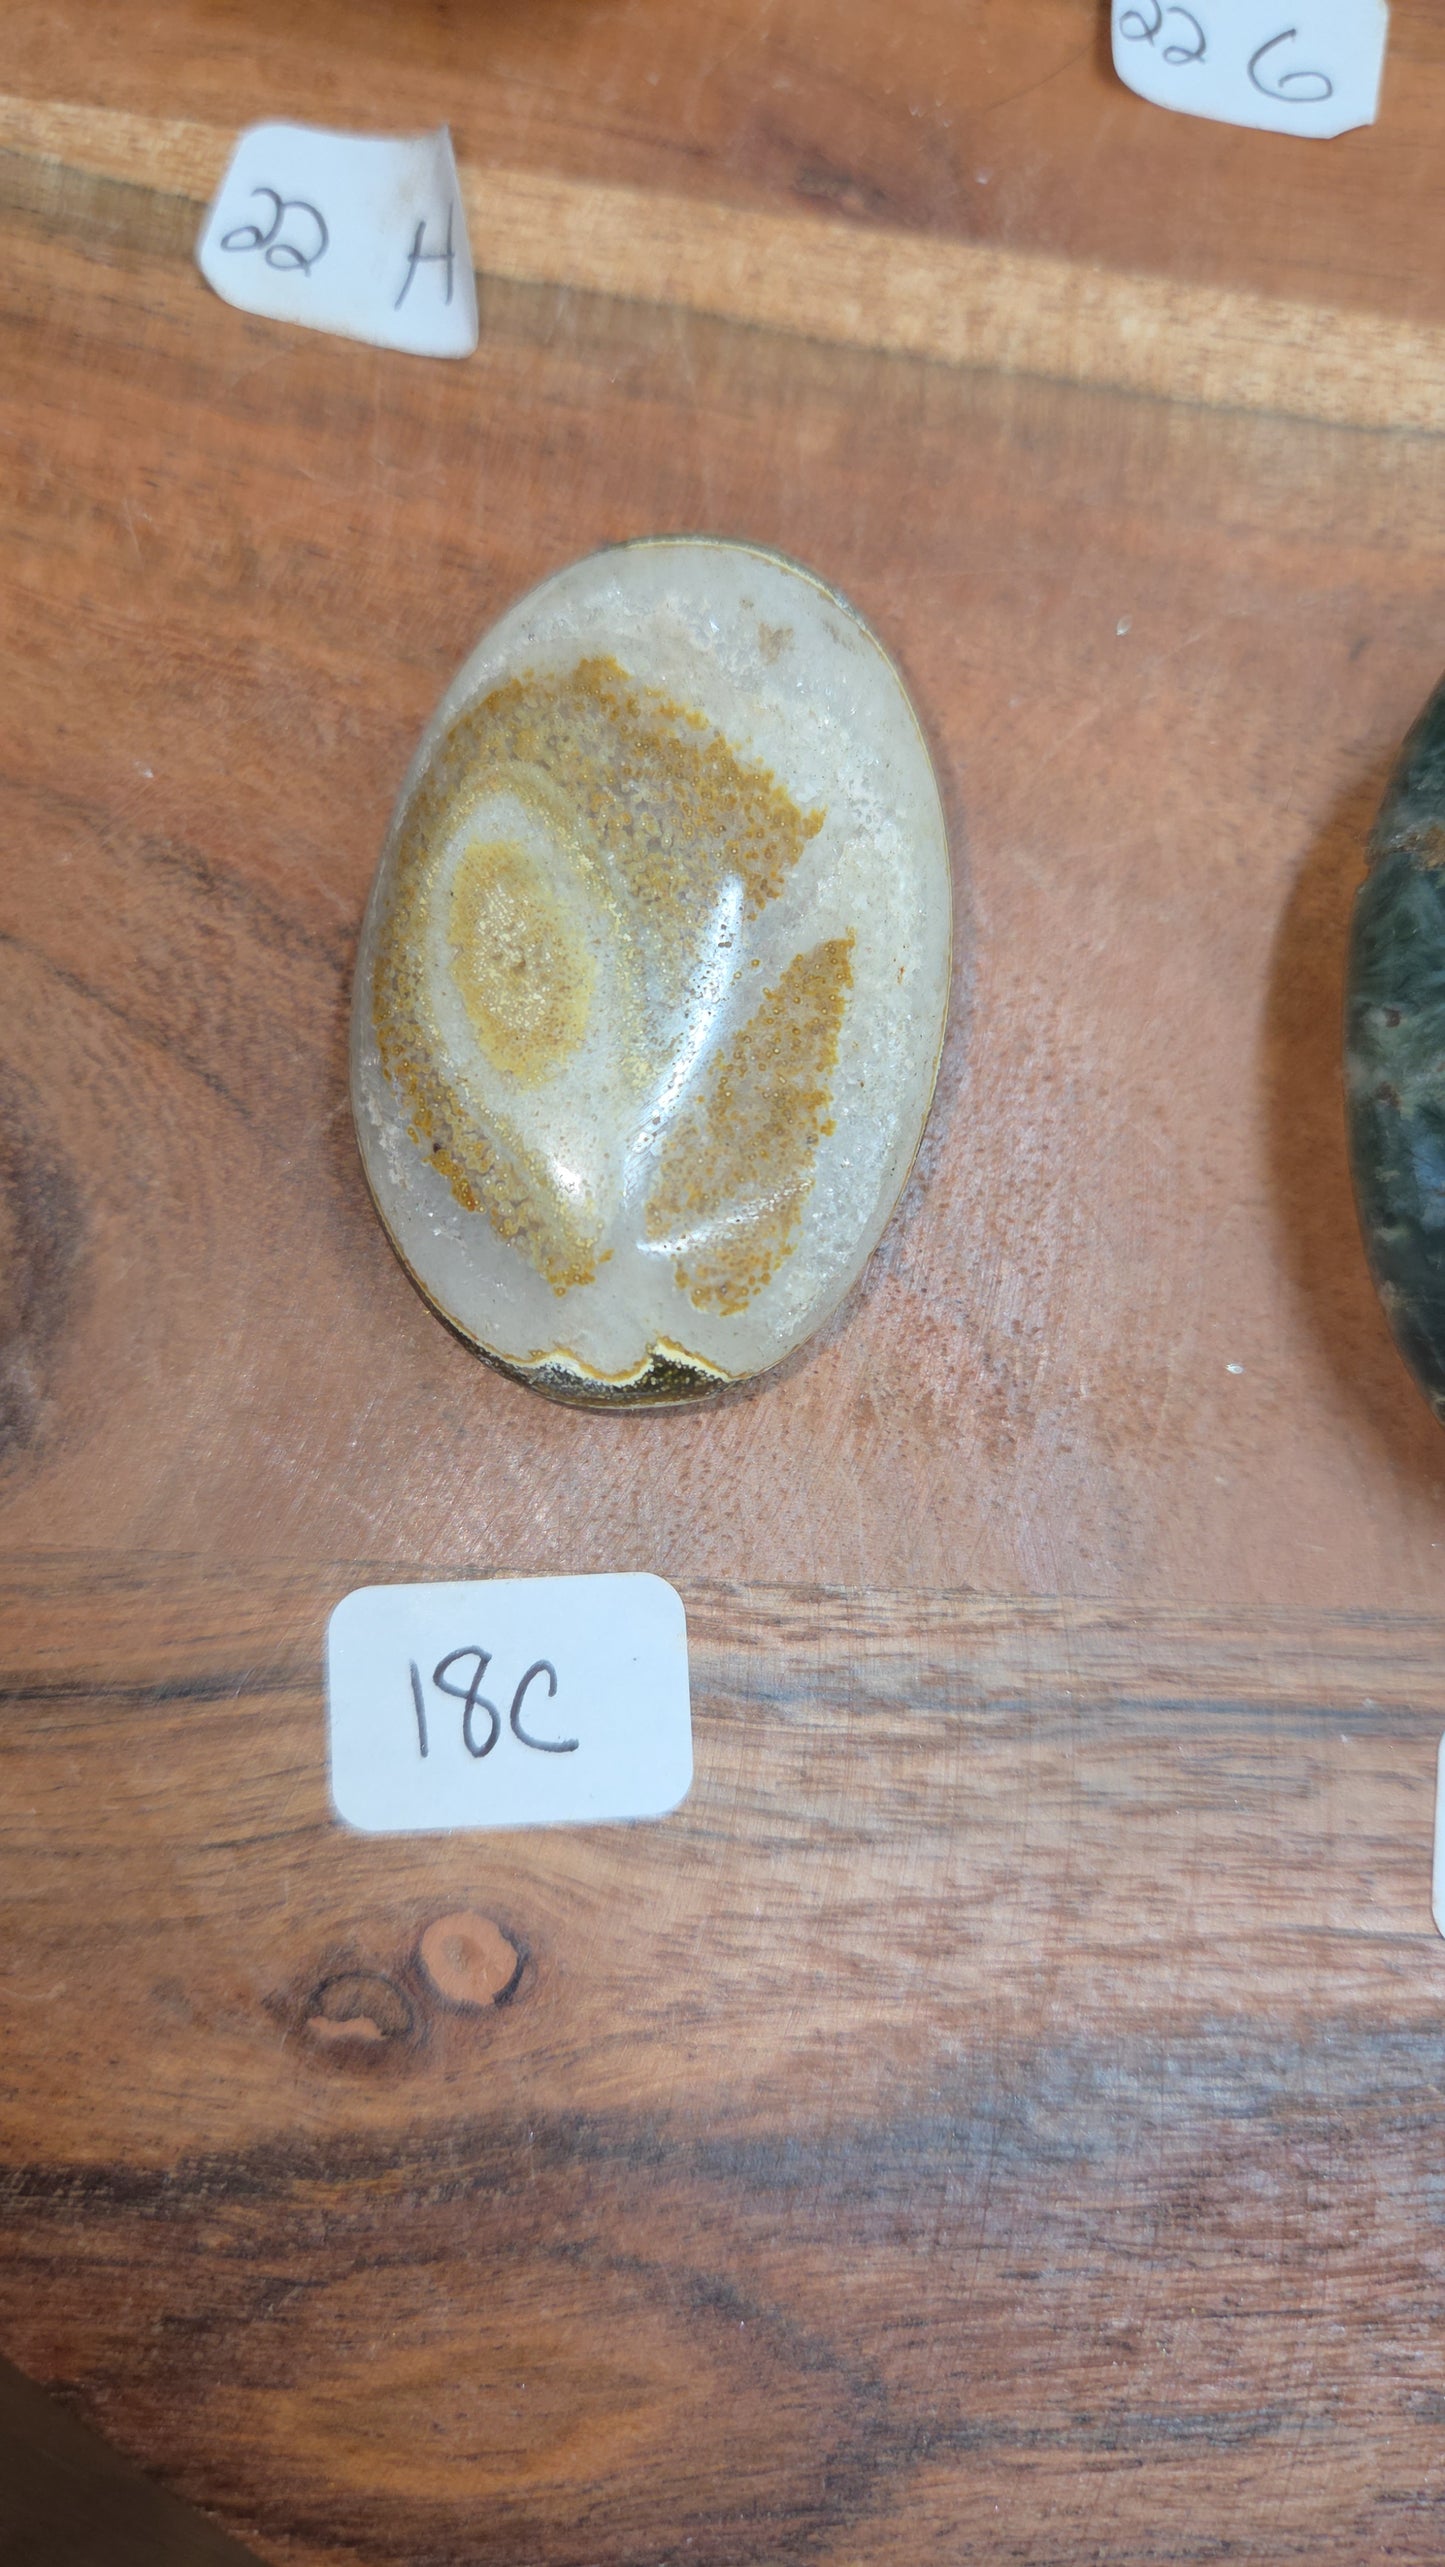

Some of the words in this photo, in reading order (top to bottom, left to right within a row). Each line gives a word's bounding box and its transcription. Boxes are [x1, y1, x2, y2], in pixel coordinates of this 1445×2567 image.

[1118, 0, 1207, 65] 22
[219, 186, 330, 278] 22
[393, 199, 456, 312] H
[408, 1644, 580, 1759] 18C
